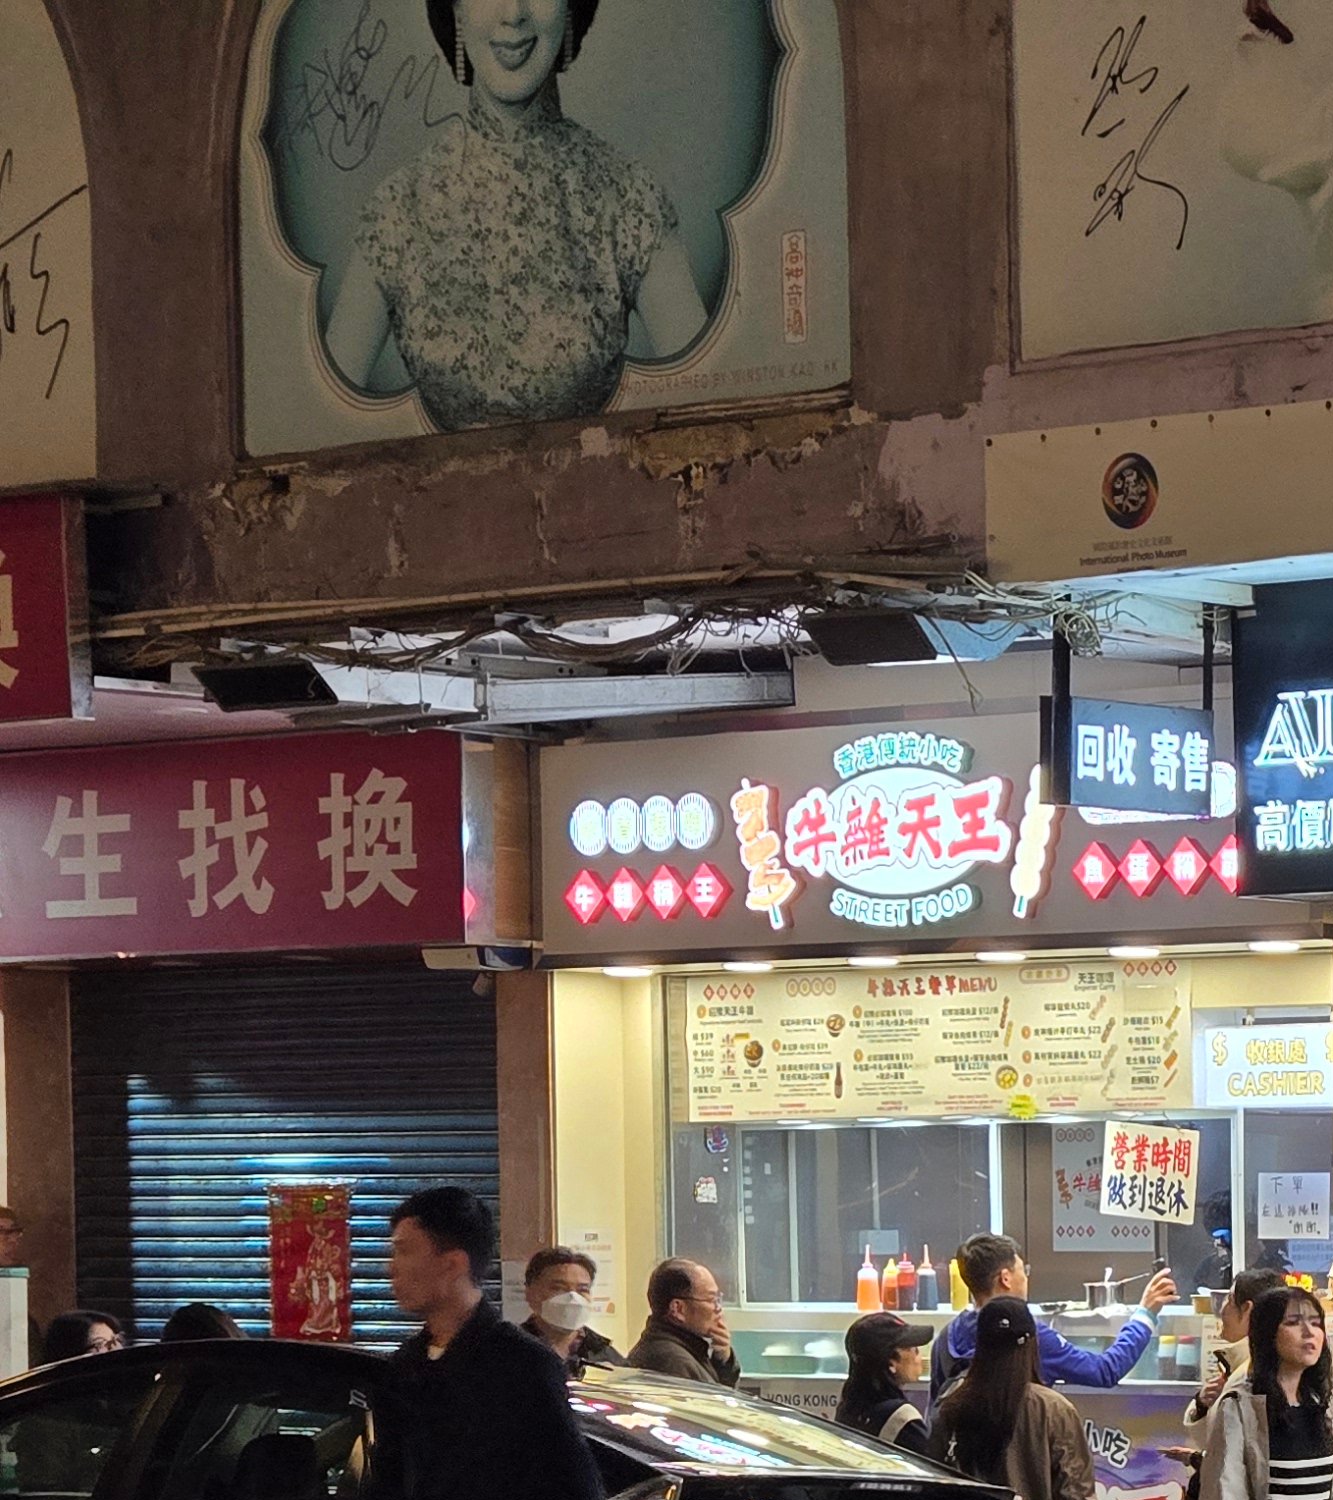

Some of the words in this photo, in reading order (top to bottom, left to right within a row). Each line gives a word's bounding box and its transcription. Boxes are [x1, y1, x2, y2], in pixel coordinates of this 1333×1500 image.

[1077, 723, 1137, 786] 回收
[1150, 728, 1209, 793] 寄售
[792, 788, 1002, 867] 牛雜天王
[832, 889, 909, 926] STREET
[912, 885, 970, 922] FOOD
[1246, 1037, 1308, 1065] 收銀處
[1227, 1070, 1326, 1098] CASHIER
[1110, 1131, 1193, 1179] 營業時間
[803, 1394, 837, 1407] KONG
